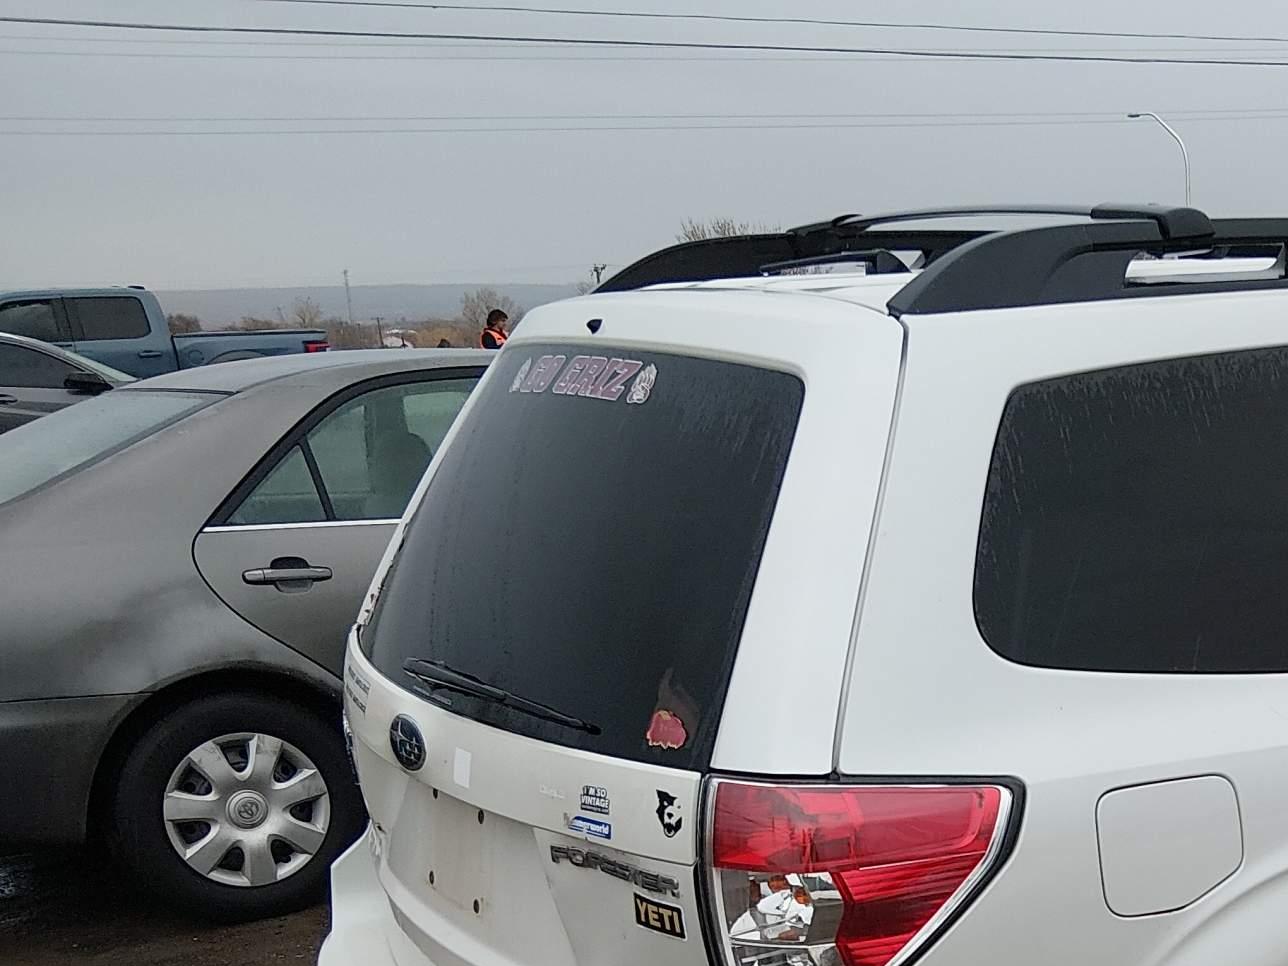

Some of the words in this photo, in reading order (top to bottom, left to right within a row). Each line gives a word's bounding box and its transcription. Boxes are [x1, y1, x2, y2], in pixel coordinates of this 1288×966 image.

[519, 355, 566, 393] GO
[581, 795, 609, 809] VINTAGE
[595, 788, 606, 798] SO
[550, 845, 680, 898] FORESTER
[636, 898, 681, 933] YETI
